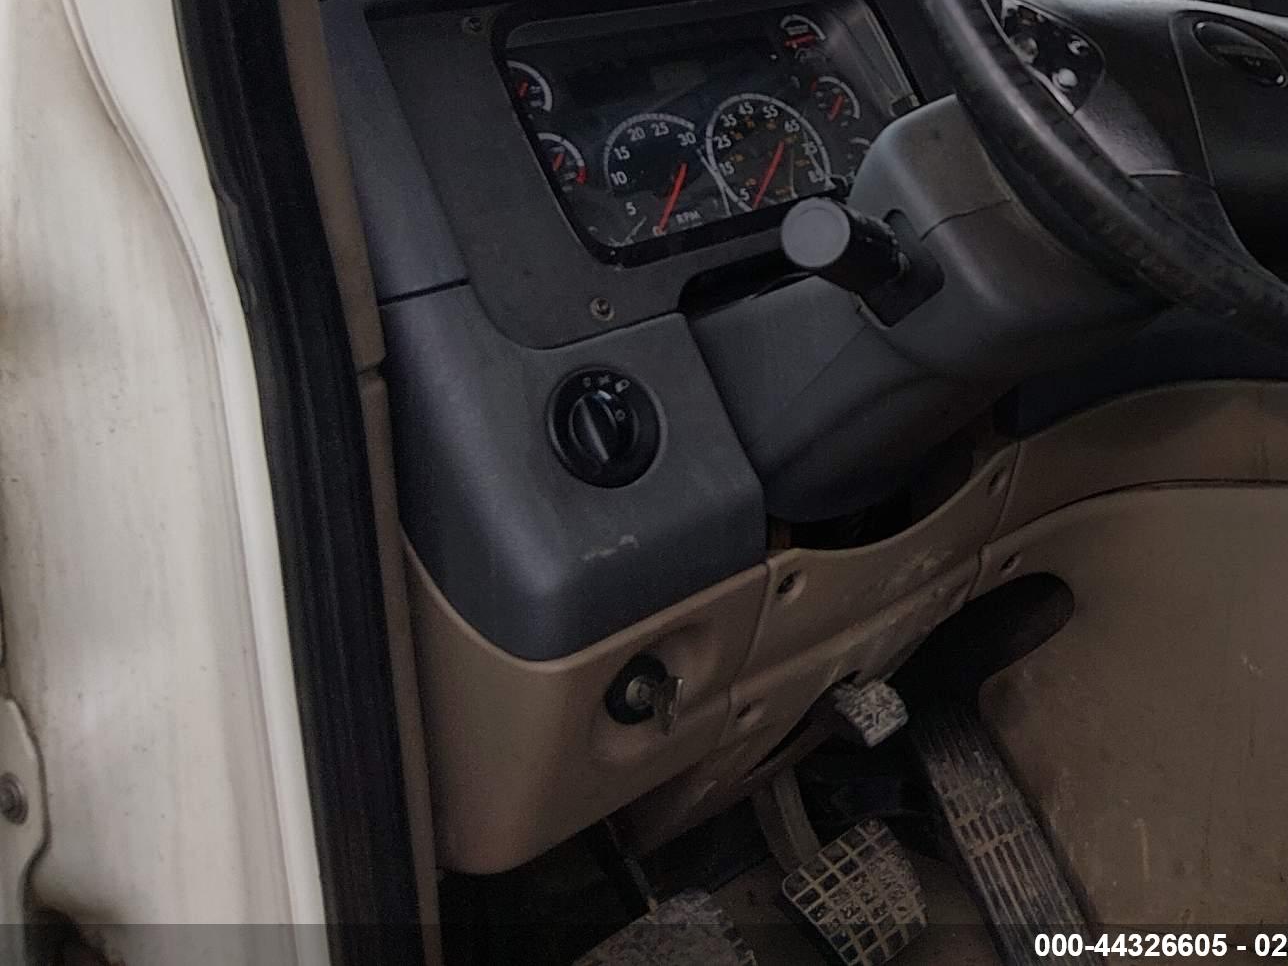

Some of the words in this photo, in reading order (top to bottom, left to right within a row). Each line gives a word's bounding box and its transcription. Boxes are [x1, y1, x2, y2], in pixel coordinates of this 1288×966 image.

[762, 104, 779, 119] 55
[720, 113, 737, 128] 35
[784, 118, 801, 133] 65
[627, 126, 646, 142] 20
[651, 121, 670, 137] 25
[677, 131, 697, 147] 30
[713, 134, 732, 150] 25
[613, 145, 631, 161] 15
[718, 160, 736, 176] 15
[610, 171, 628, 186] 10
[739, 188, 750, 202] 5
[625, 201, 637, 216] 5
[675, 209, 702, 225] RPM
